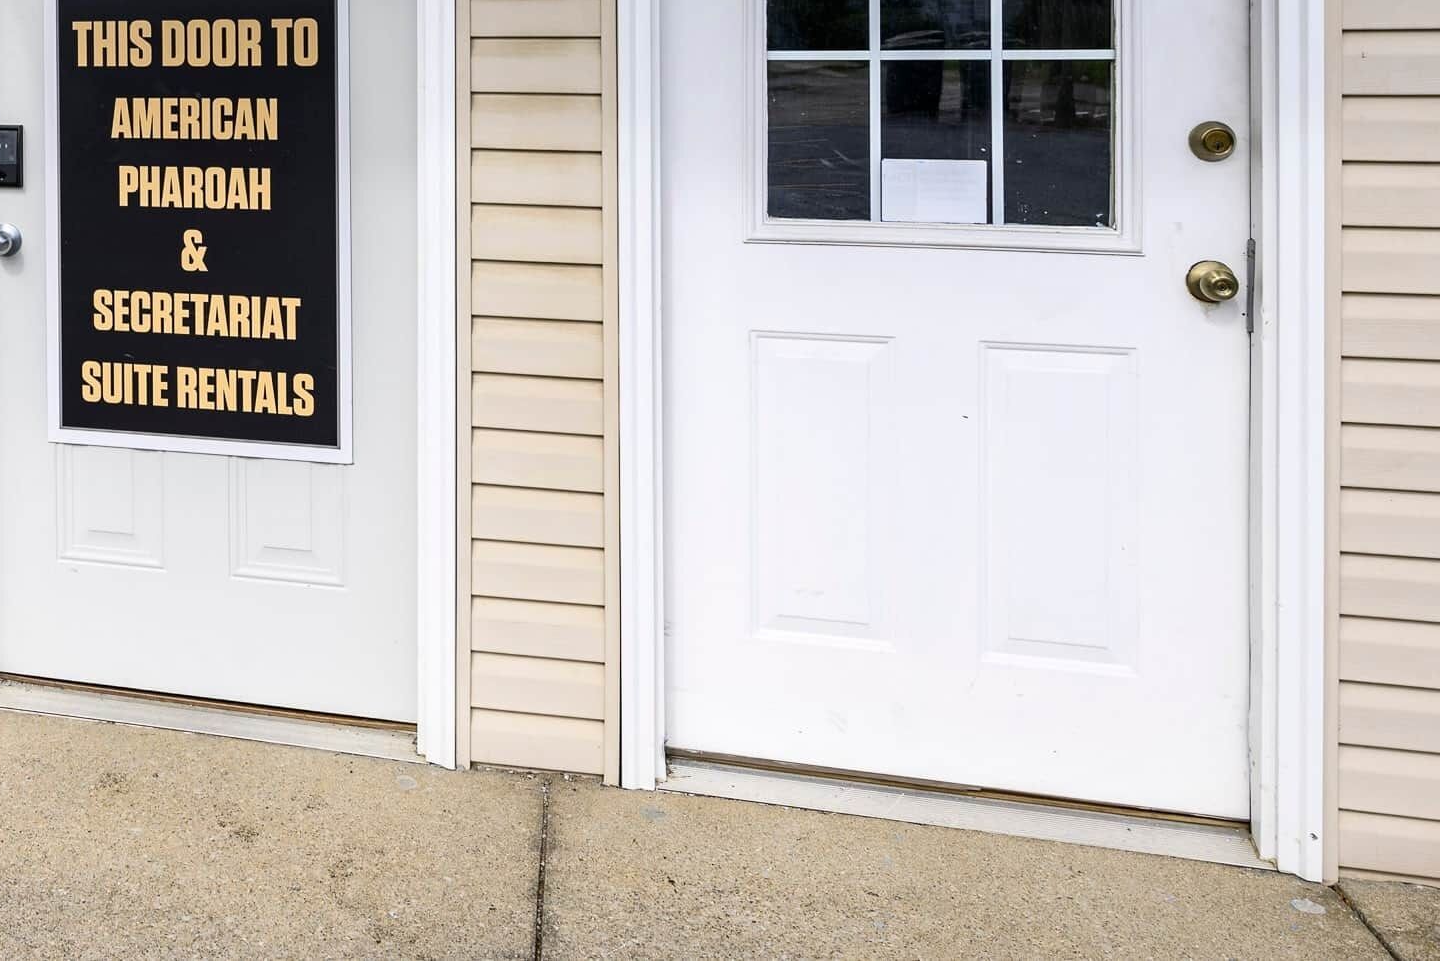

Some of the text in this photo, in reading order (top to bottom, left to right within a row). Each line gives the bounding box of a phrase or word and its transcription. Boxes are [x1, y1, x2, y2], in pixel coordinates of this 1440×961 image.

[72, 17, 319, 67] THIS DOOR TO
[111, 97, 278, 140] AMERICAN
[118, 165, 271, 210] PHAROAH
[180, 229, 209, 272] &
[93, 289, 302, 340] SECRETARIAT
[81, 360, 315, 416] SUITE RENTALS
